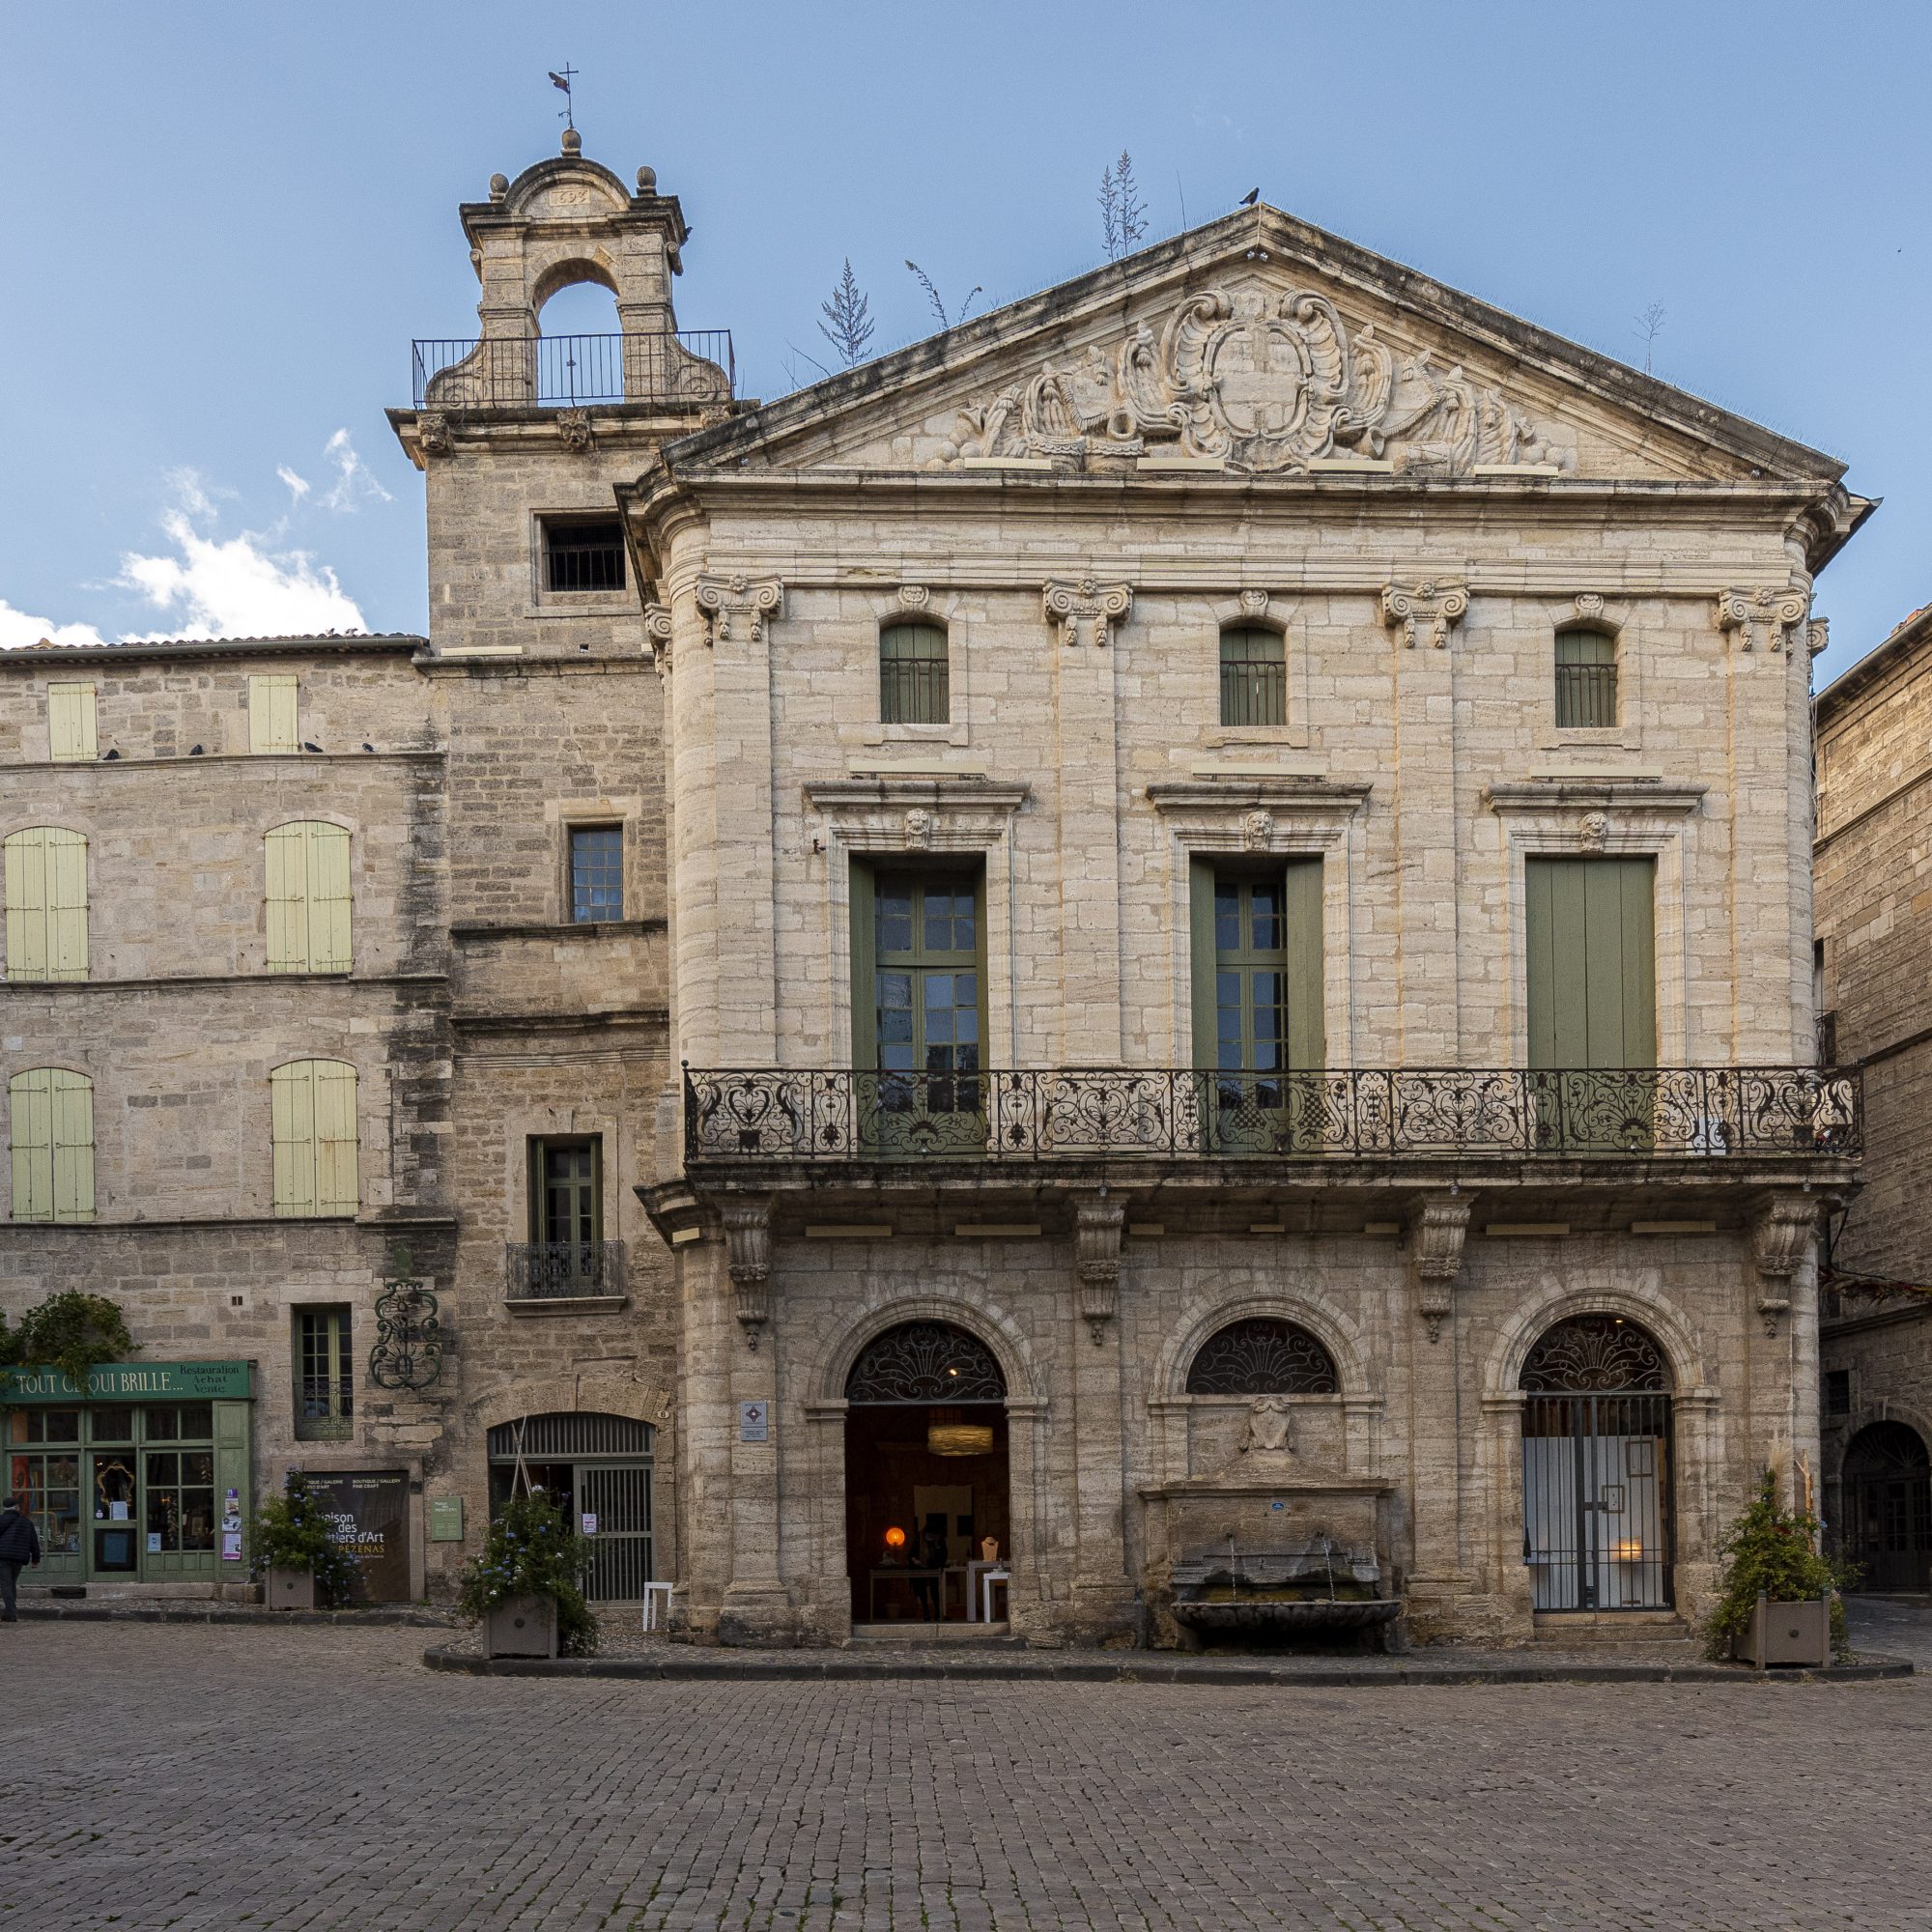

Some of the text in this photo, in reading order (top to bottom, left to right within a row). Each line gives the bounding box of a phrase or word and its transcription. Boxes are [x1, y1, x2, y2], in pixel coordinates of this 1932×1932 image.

[180, 1364, 240, 1375] Restauration
[16, 1375, 57, 1393] TOUT
[88, 1373, 115, 1396] QUI
[120, 1372, 184, 1392] BRILLE...
[192, 1376, 227, 1384] Achat
[193, 1384, 225, 1393] Vente
[323, 1512, 354, 1523] aison
[338, 1522, 357, 1533] des
[325, 1531, 384, 1544] étiers d'Art
[338, 1544, 384, 1553] PÉZENAS
